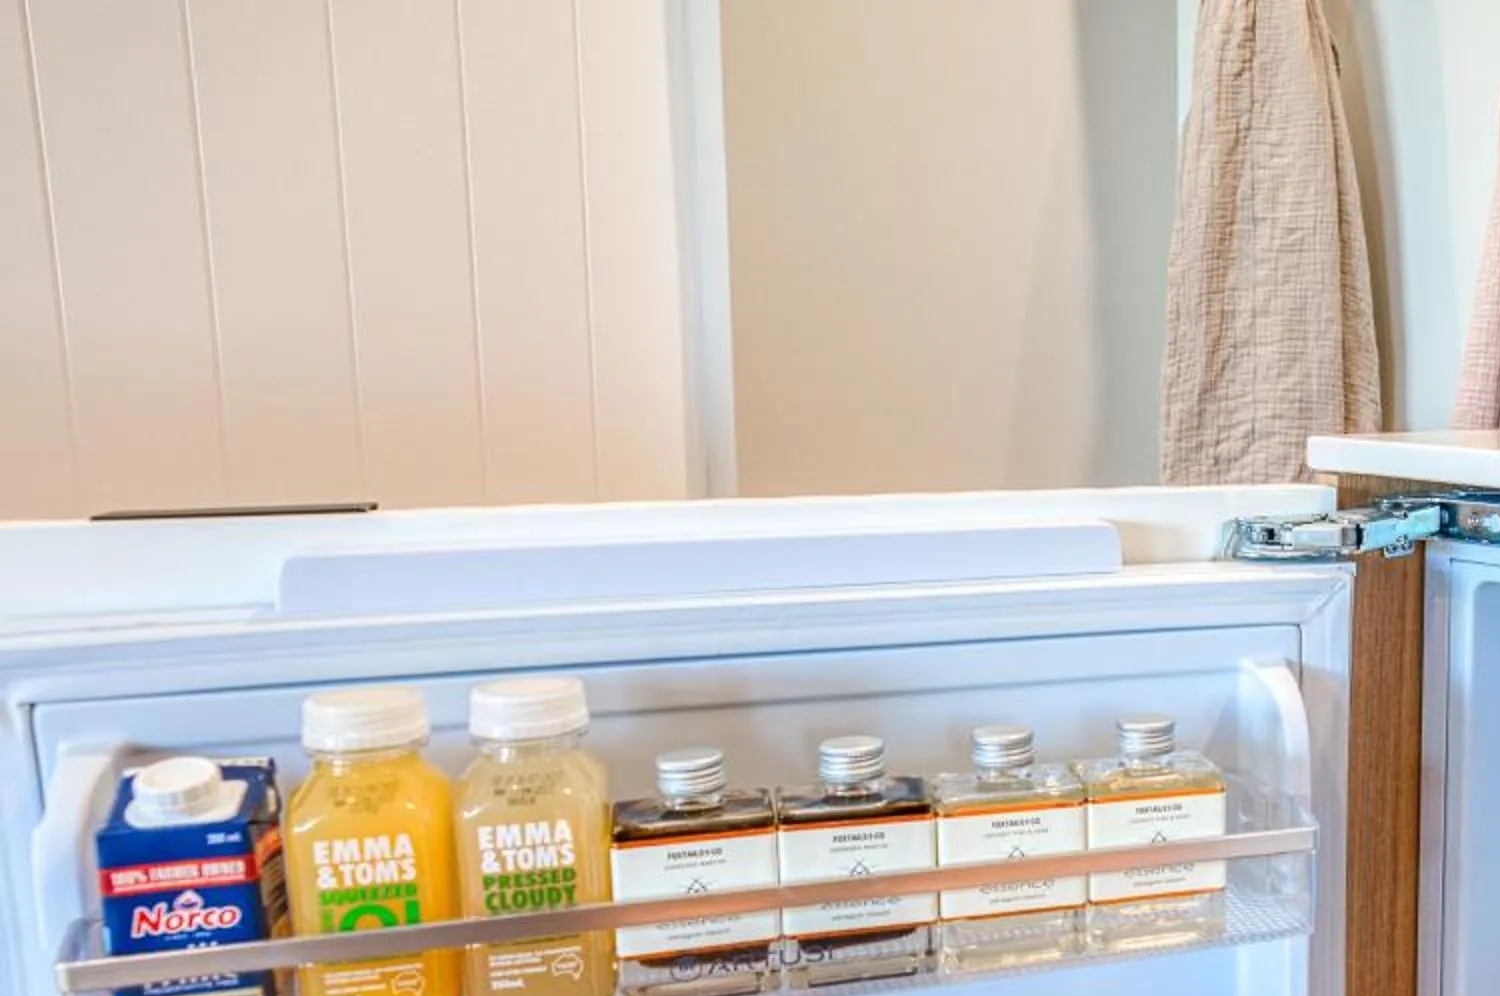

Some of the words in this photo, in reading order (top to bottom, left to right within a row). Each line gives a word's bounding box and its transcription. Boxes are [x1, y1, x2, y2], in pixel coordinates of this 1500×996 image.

[313, 833, 415, 865] EMMA
[478, 820, 573, 850] EMMA
[317, 864, 338, 889] &
[481, 851, 501, 873] &
[482, 868, 577, 890] PRESSED
[484, 884, 577, 913] CLOUDY
[131, 901, 242, 939] Norco
